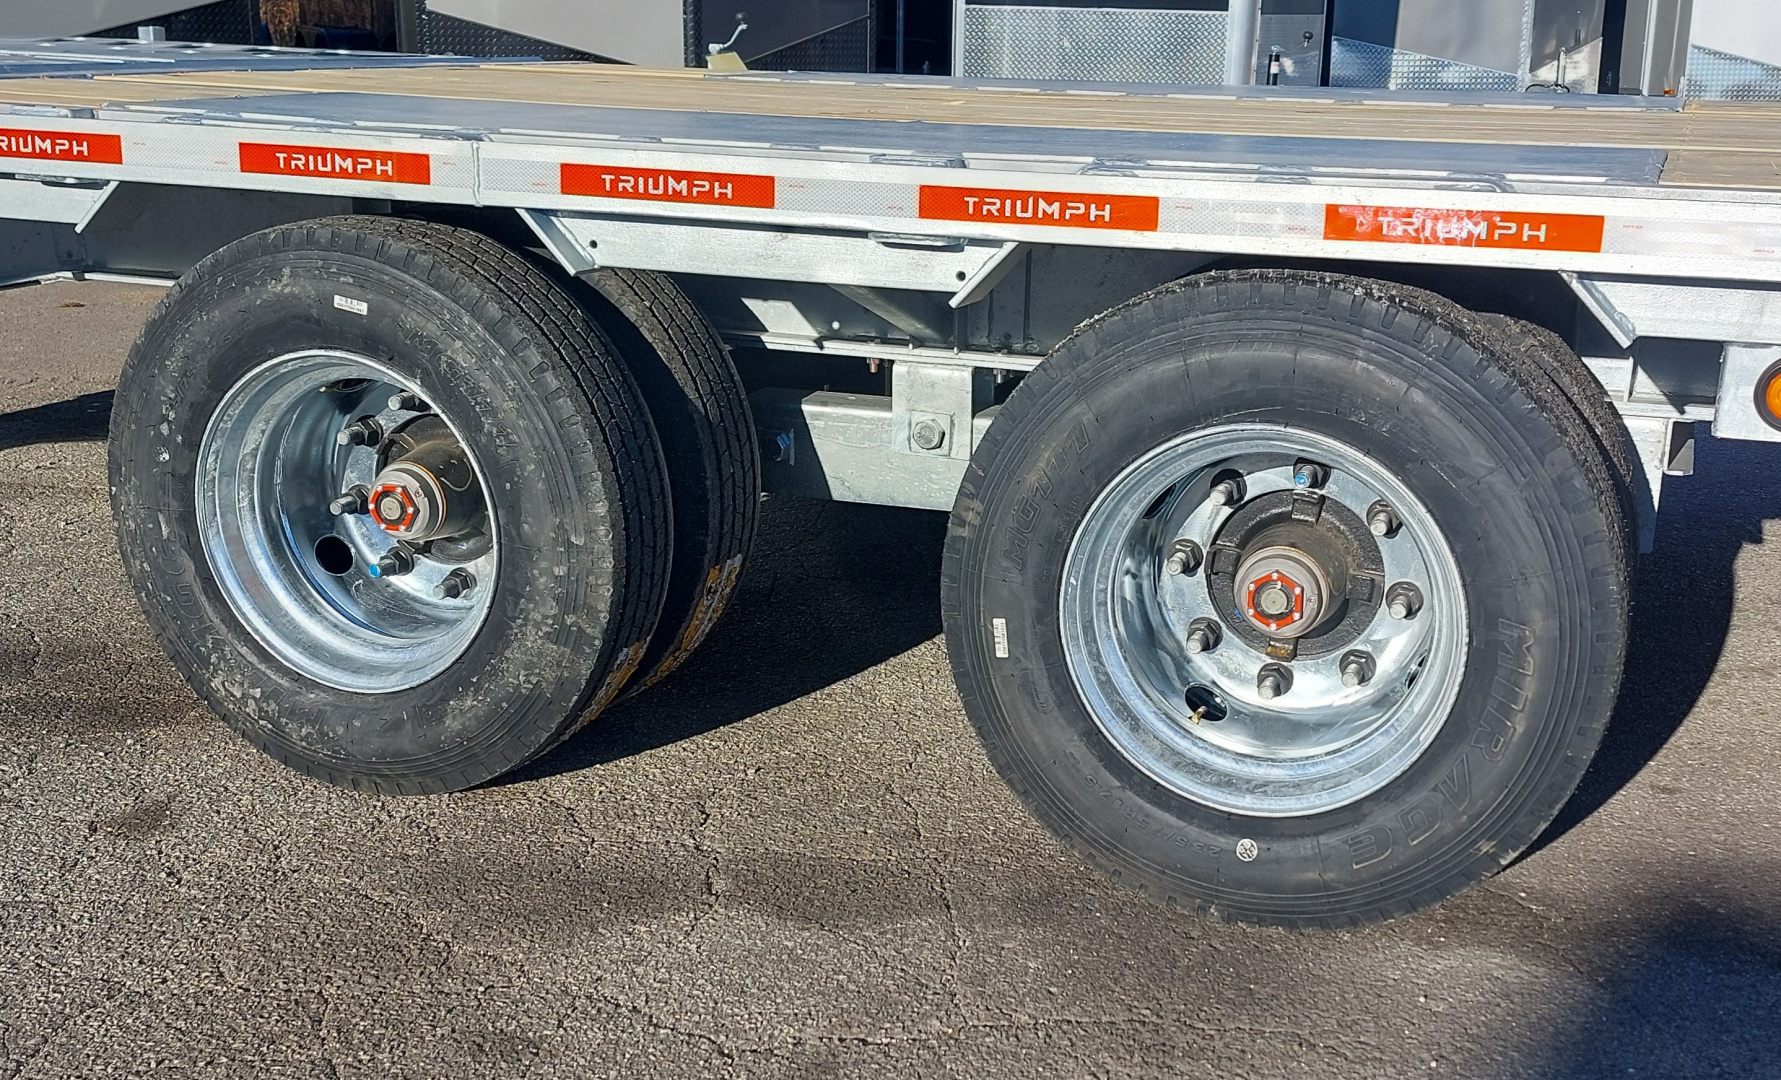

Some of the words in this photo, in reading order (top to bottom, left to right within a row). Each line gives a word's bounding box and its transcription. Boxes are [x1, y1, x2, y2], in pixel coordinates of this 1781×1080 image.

[0, 134, 89, 157] RIUMPH
[275, 152, 393, 177] TRIUMPH
[601, 174, 733, 200] TRIUMPH
[963, 195, 1111, 222] TRIUMPH
[1377, 215, 1548, 243] TRIUMPH
[1348, 617, 1536, 870] MIRAGE
